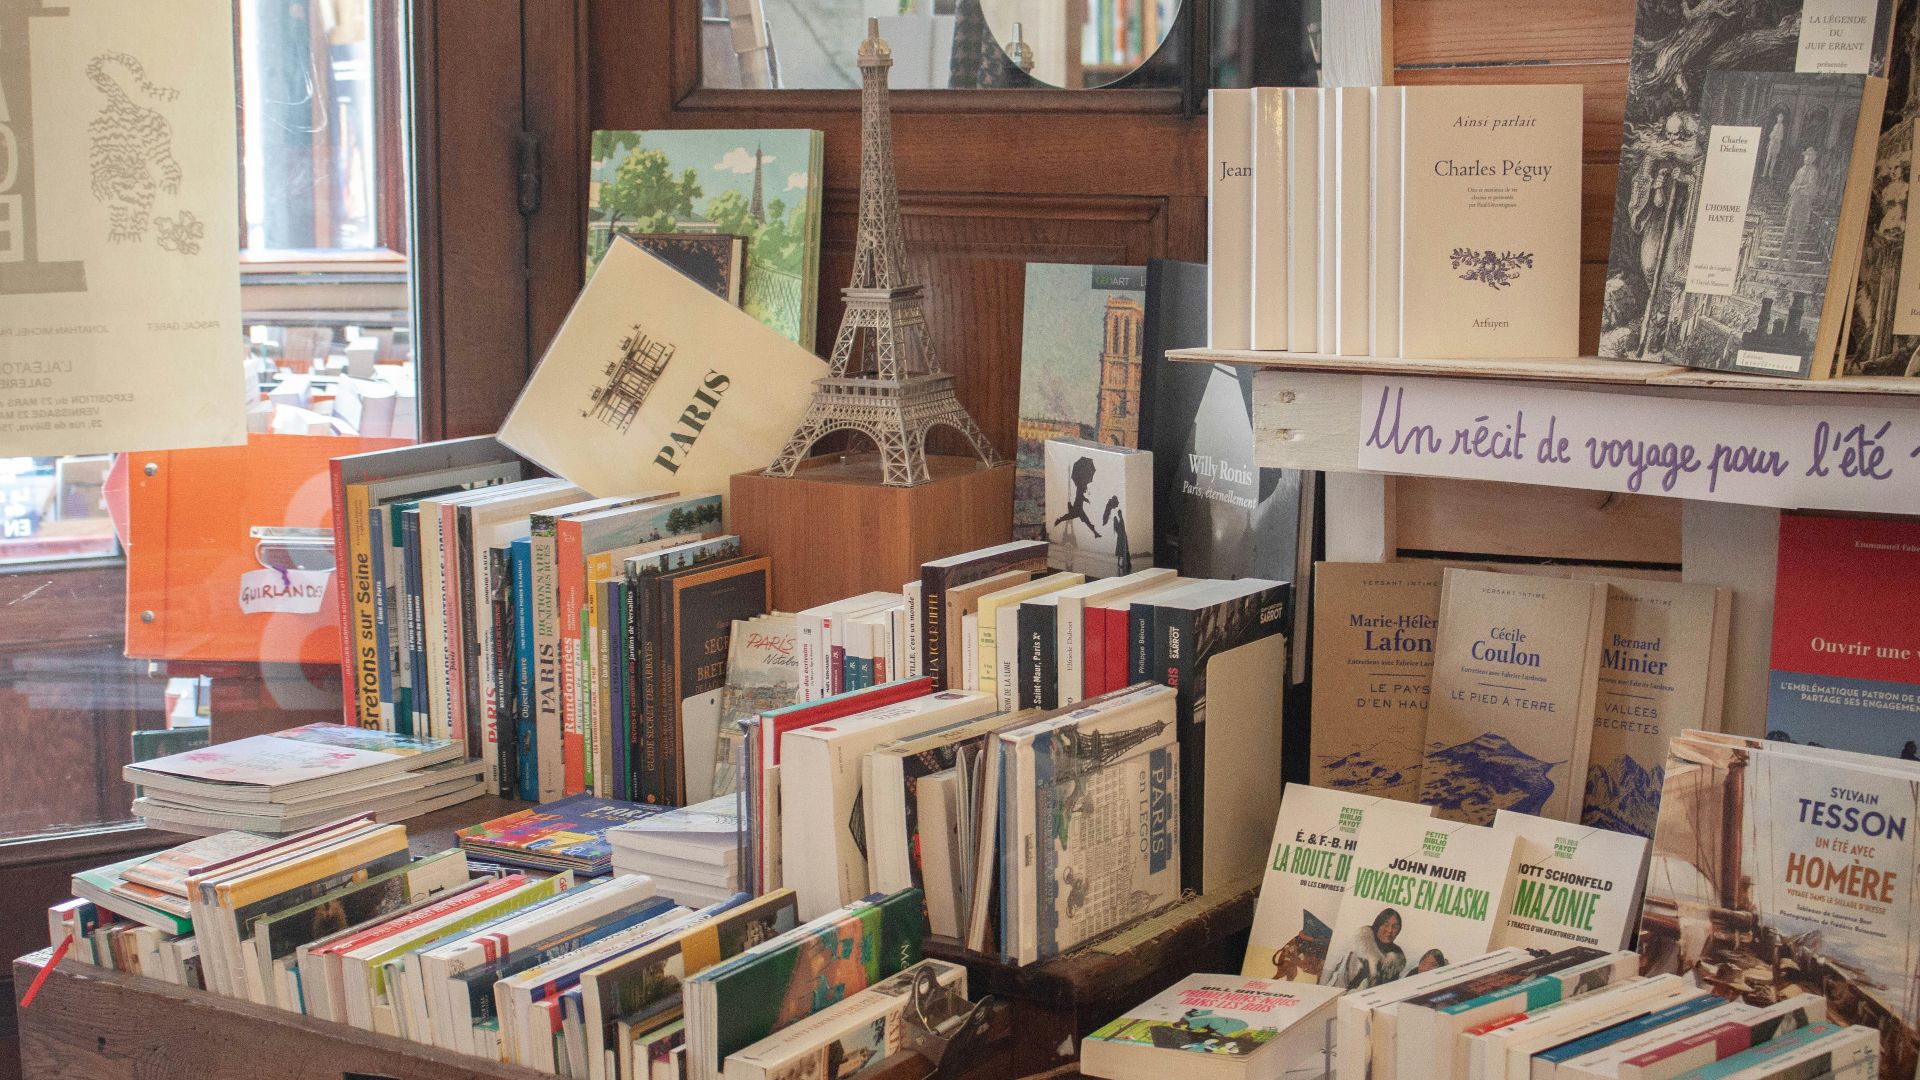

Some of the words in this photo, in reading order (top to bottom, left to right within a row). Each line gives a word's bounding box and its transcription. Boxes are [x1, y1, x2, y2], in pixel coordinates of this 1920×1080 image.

[1809, 16, 1820, 24] LA
[1822, 14, 1867, 24] LÉGENDE
[1829, 29, 1843, 37] DU
[1805, 42, 1826, 50] JUIF
[1828, 42, 1864, 50] ERRANT
[1453, 115, 1489, 128] Ainsi
[1492, 115, 1537, 131] parlait
[1719, 145, 1747, 154] Dickens
[1721, 135, 1748, 144] Charles
[1434, 160, 1496, 177] Charles
[1502, 160, 1552, 182] Péguy
[1705, 203, 1741, 213] L'HOMME
[1472, 317, 1509, 330] Arfuyen
[652, 368, 731, 475] PARIS
[1365, 384, 1442, 456] Un
[1447, 408, 1527, 460] récit
[1536, 414, 1572, 464] de
[1584, 434, 1702, 493] voyage
[1706, 440, 1789, 493] pour
[1805, 420, 1893, 481] l'été
[1188, 453, 1219, 484] Willy
[1219, 459, 1252, 485] Ronis
[356, 553, 370, 604] Seine
[242, 584, 324, 603] GUIRLANDES
[535, 544, 546, 637] DICTIONNAIRE
[626, 591, 634, 624] Versailles
[1260, 606, 1283, 624] SARROT
[360, 610, 374, 640] sur
[628, 625, 635, 635] de
[909, 623, 916, 633] un
[1490, 627, 1526, 643] Cécile
[746, 633, 796, 655] PARIS
[1033, 641, 1041, 661] Paris
[1172, 626, 1180, 660] SARROT
[1364, 629, 1432, 653] Lafon
[1612, 634, 1660, 652] Bernard
[1811, 636, 1871, 658] Ouvrir
[1876, 646, 1910, 661] une
[1138, 646, 1146, 674] Philippe
[1471, 640, 1540, 667] Coulon
[1601, 648, 1668, 676] Minier
[519, 656, 528, 685] Louvre
[539, 642, 556, 715] PARIS
[1003, 660, 1011, 677] LUNE
[360, 646, 380, 730] Bretons
[563, 636, 575, 735] Randonnées
[1033, 661, 1042, 704] Saint-Maur,
[1370, 683, 1387, 693] LE
[1393, 684, 1432, 695] PAYS
[520, 687, 530, 718] Objectif
[1357, 697, 1392, 708] D'EN
[1451, 690, 1465, 701] LE
[1469, 691, 1498, 704] PIED
[1515, 697, 1556, 713] TERRE
[1801, 693, 1842, 706] PARTAGE
[1844, 697, 1861, 707] SES
[1862, 689, 1899, 702] PATRON
[485, 687, 498, 743] PARIS
[1139, 770, 1148, 798] en
[1830, 787, 1880, 806] SYLVAIN
[1151, 767, 1164, 854] PARIS
[1799, 798, 1907, 842] TESSON
[1308, 834, 1317, 845] &
[1553, 843, 1577, 854] PAYOT
[1815, 836, 1829, 849] UN
[1831, 836, 1849, 853] ÉTÉ
[1850, 843, 1875, 858] AVEC
[1272, 842, 1289, 872] LA
[1290, 846, 1333, 880] ROUTE
[1388, 858, 1429, 874] JOHN
[1430, 865, 1467, 882] MUIR
[1545, 868, 1613, 892] SCHONFELD
[1785, 852, 1898, 904] HOMÈRE
[1353, 867, 1412, 906] VOYAGES
[1414, 880, 1433, 910] EN
[1434, 885, 1491, 922] ALASKA
[1235, 988, 1295, 998] BRYSON
